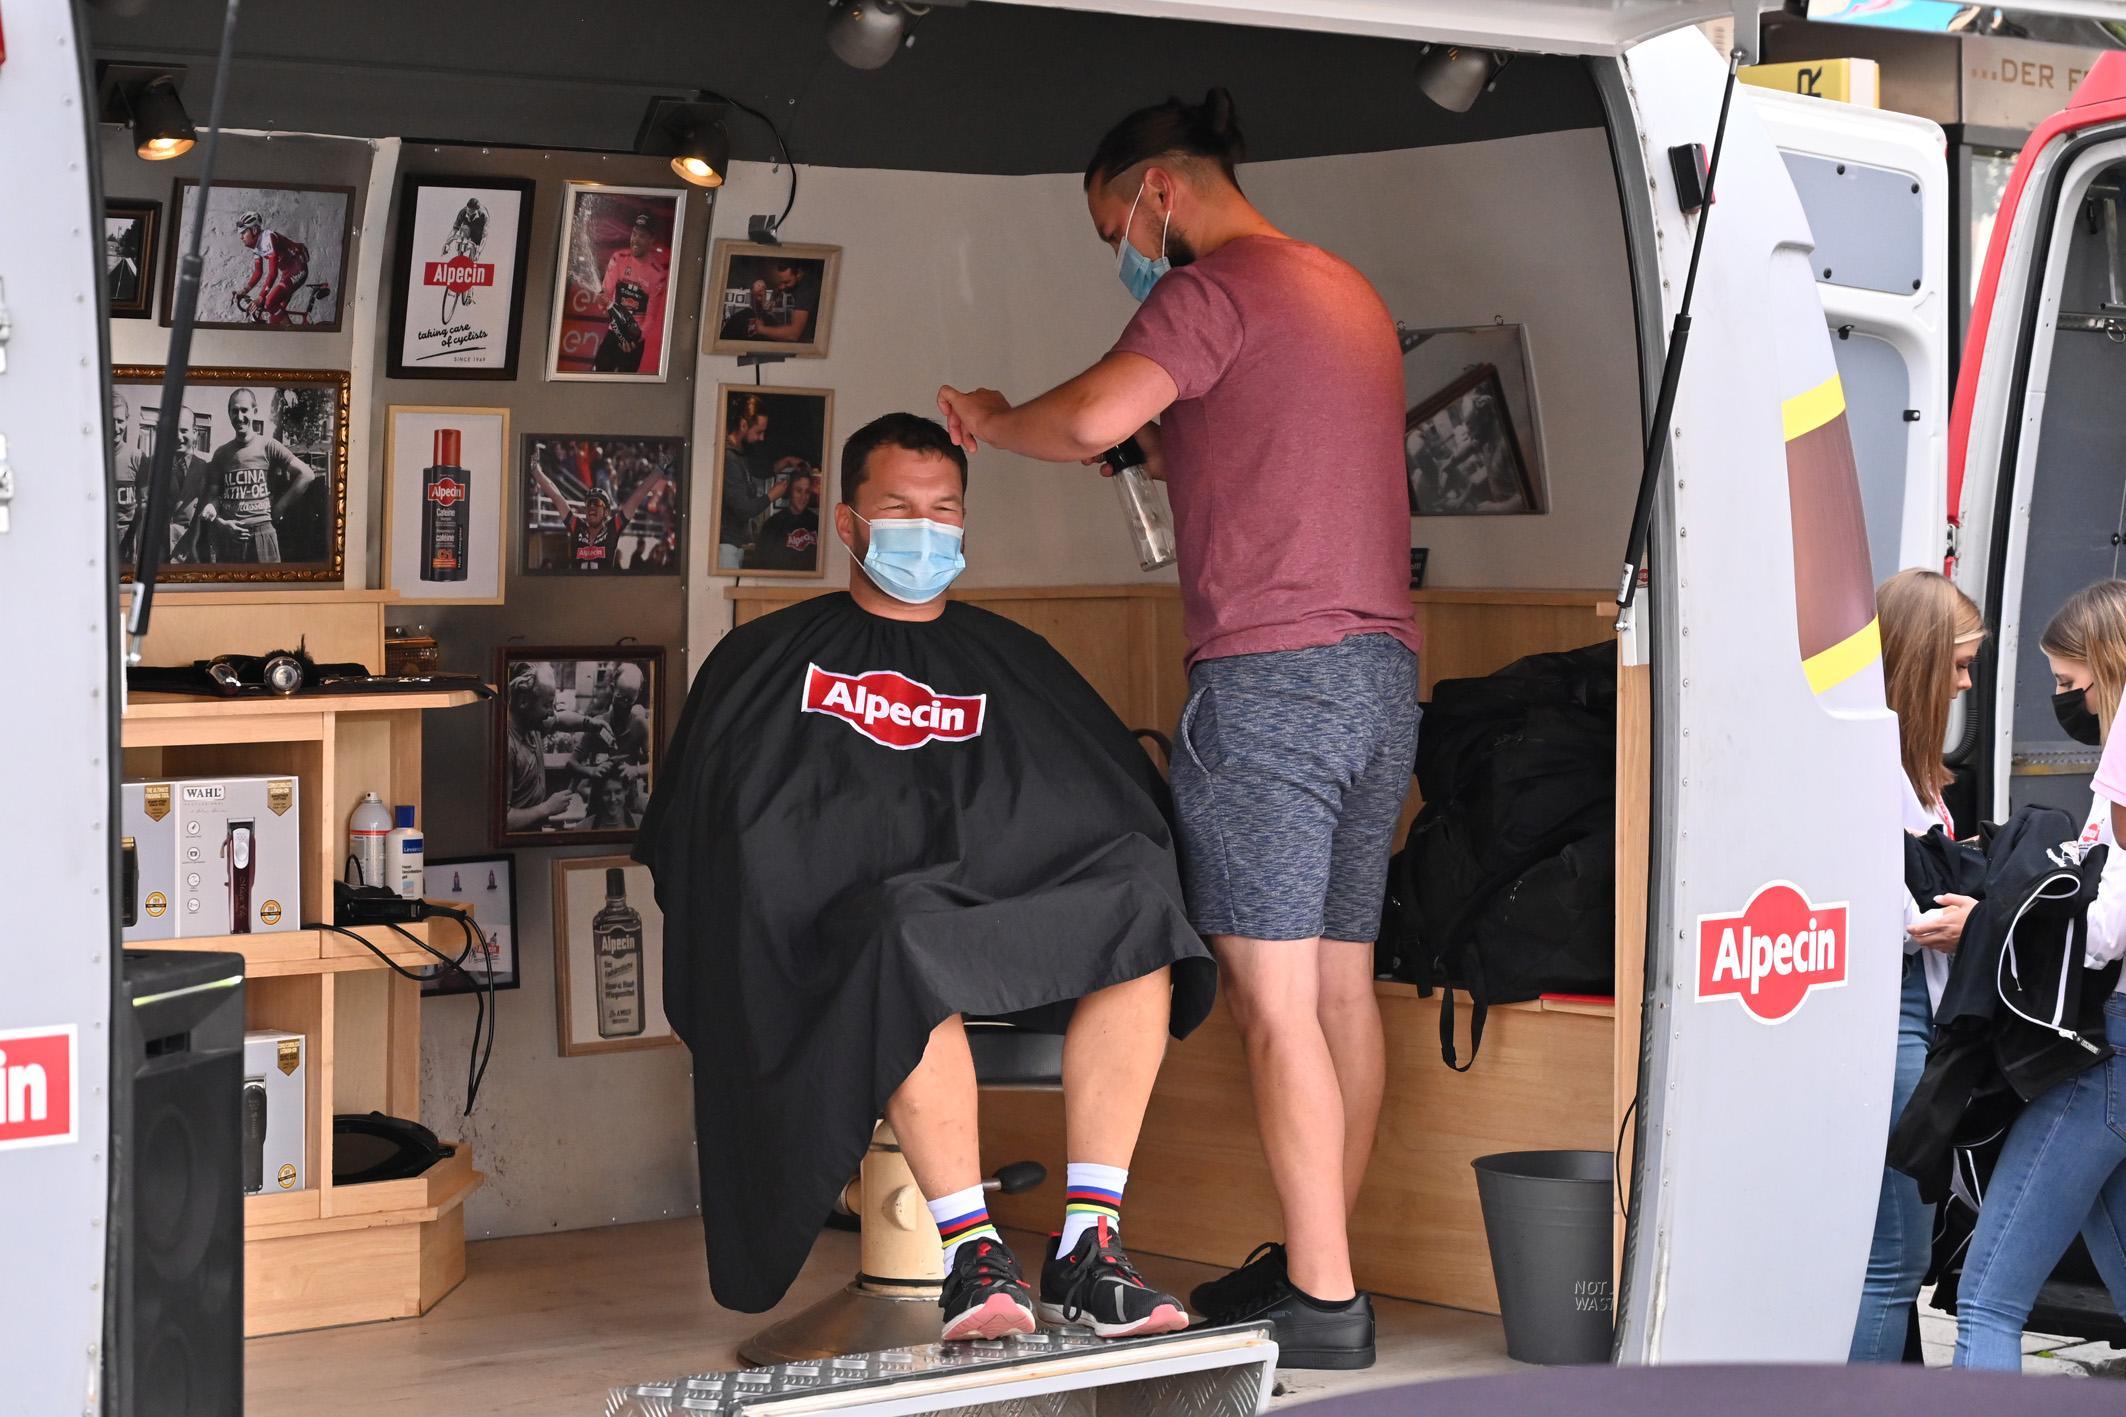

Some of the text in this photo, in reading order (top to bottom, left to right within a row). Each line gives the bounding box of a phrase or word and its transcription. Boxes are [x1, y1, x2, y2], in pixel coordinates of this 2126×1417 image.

[433, 263, 486, 286] Alpecin
[418, 323, 471, 341] taking care
[441, 329, 488, 347] of cyclists
[431, 486, 461, 500] Alpecin
[821, 681, 965, 731] Alpecin
[187, 787, 222, 798] WAHL
[601, 934, 636, 954] Alpecin
[1711, 917, 1836, 995] Alpecin
[0, 1048, 48, 1125] in
[1574, 1280, 1608, 1295] NOT
